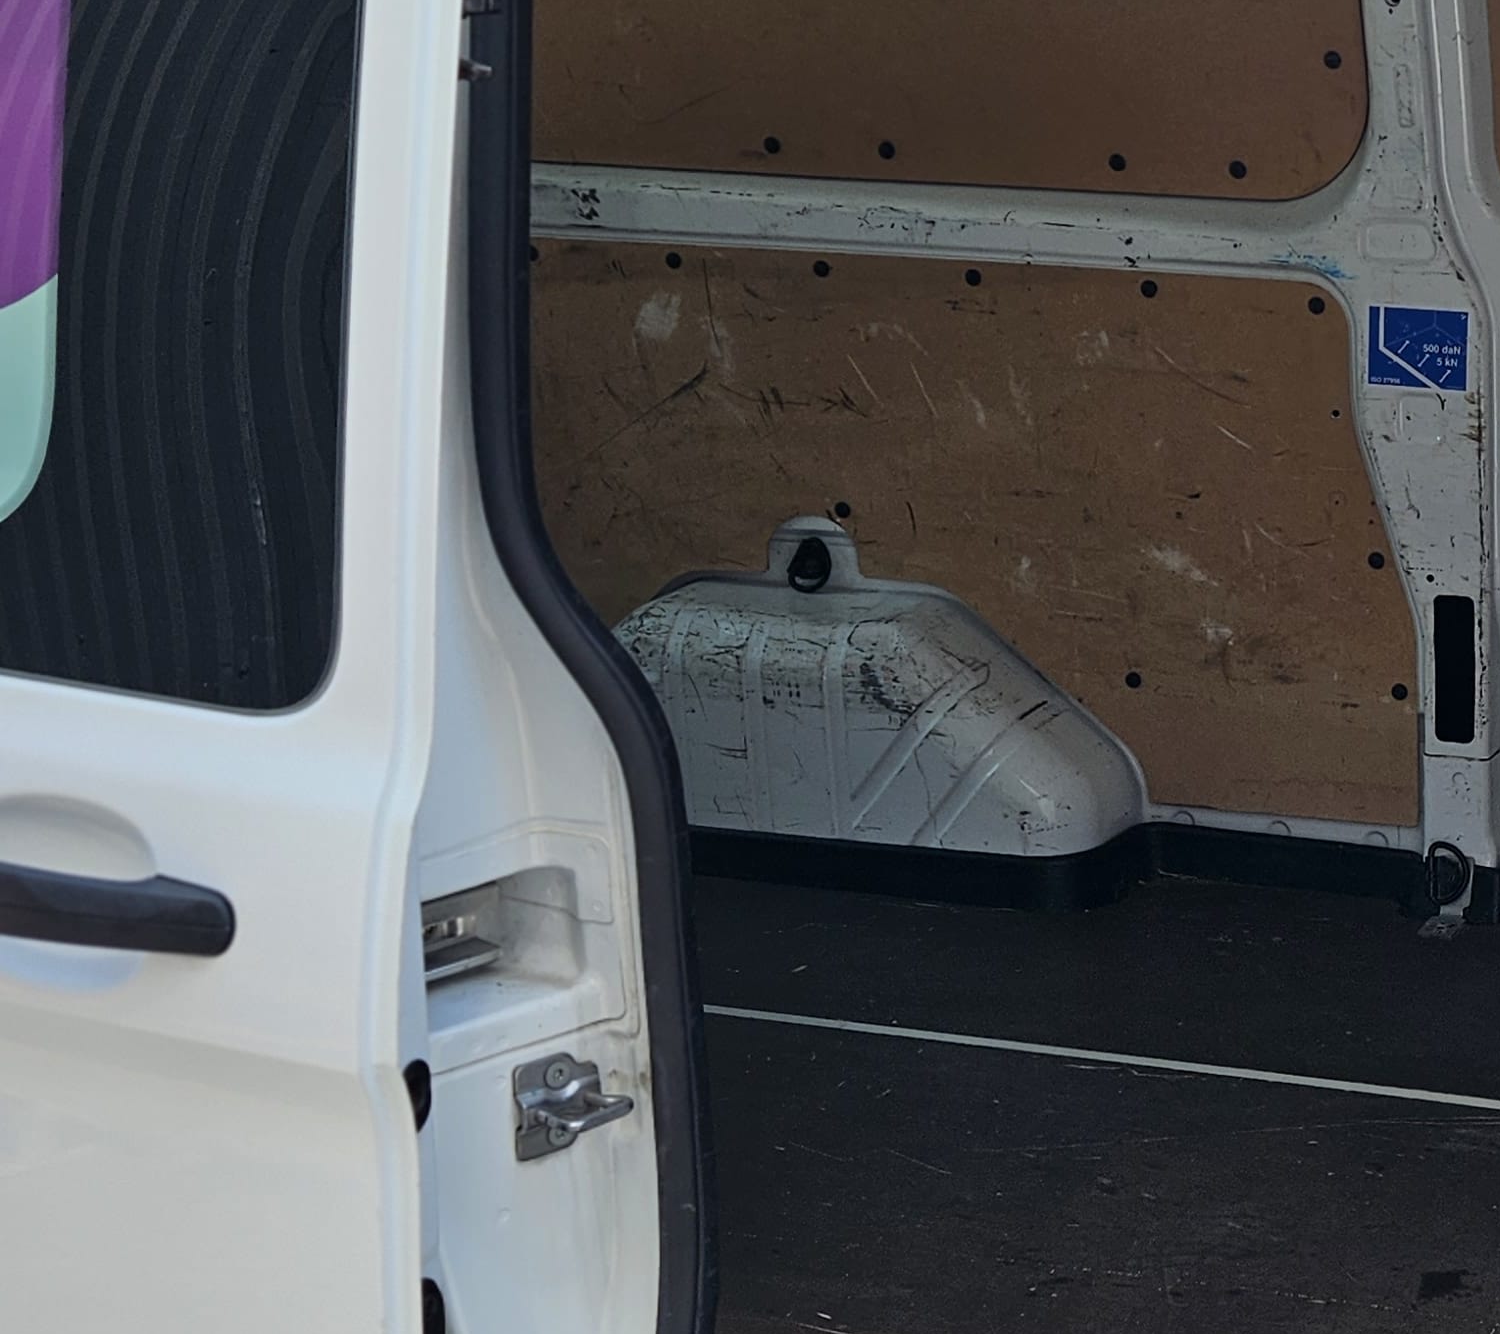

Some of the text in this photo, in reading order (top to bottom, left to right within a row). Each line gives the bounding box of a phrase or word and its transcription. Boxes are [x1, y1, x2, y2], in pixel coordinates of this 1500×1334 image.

[1423, 343, 1461, 356] 500 daN
[1436, 357, 1458, 368] 5 kN
